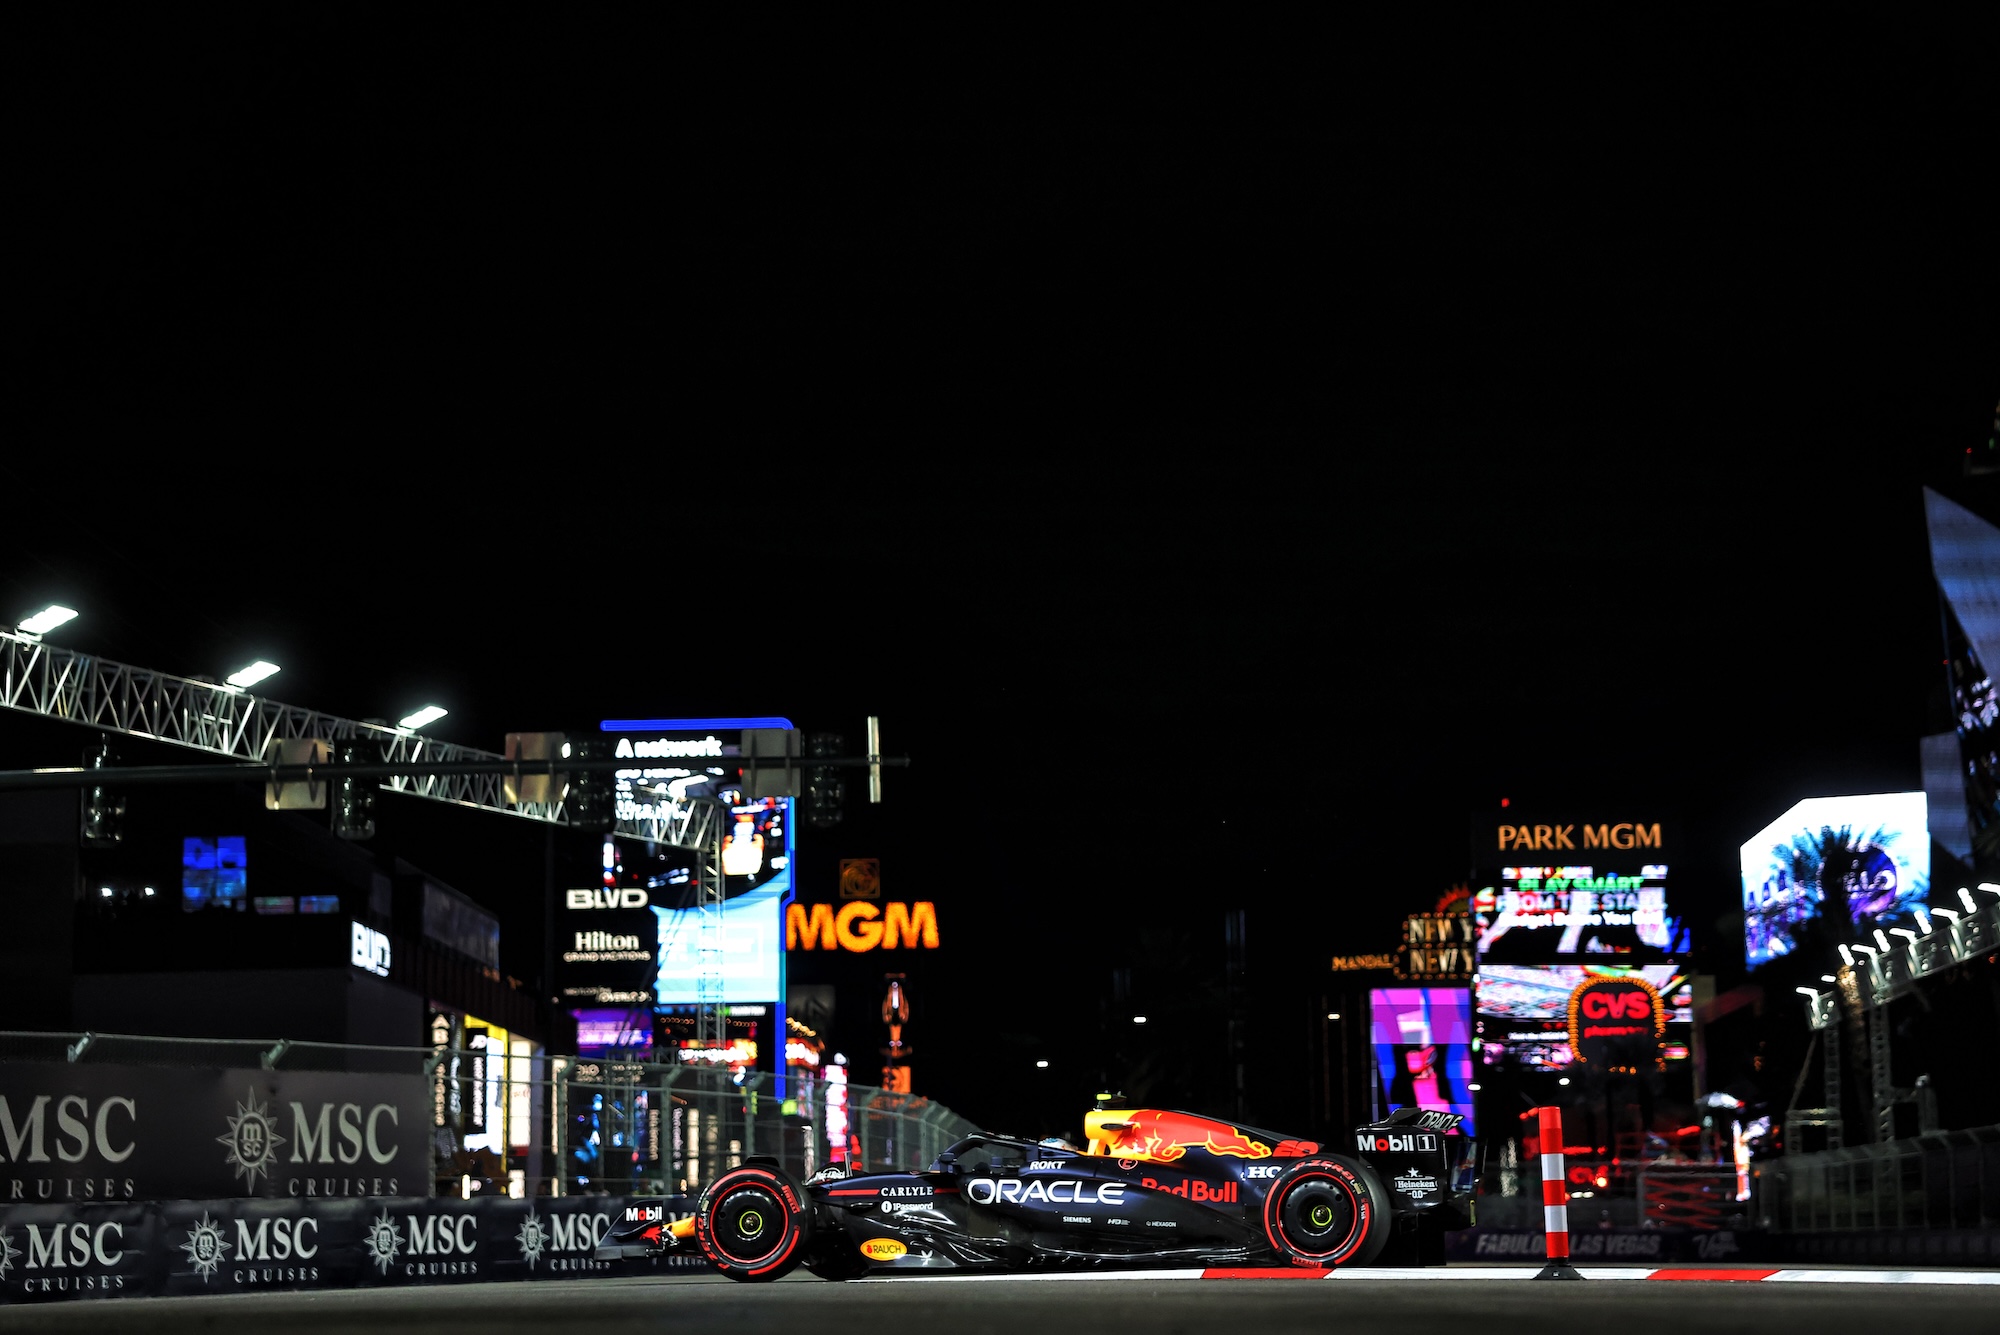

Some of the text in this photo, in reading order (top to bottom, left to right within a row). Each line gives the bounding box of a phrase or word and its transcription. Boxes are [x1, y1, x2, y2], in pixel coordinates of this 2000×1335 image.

[1497, 822, 1663, 851] PARK MGM
[1572, 876, 1645, 891] SMART
[566, 887, 648, 909] BLVD
[786, 901, 939, 953] MGM
[575, 930, 640, 951] Hilton
[1582, 991, 1651, 1019] CVS
[289, 1102, 399, 1164] MSC
[1357, 1134, 1415, 1152] Mobil
[1029, 1161, 1066, 1171] ROKT
[288, 1178, 399, 1197] CRUISES
[881, 1186, 934, 1197] CARLYLE
[967, 1178, 1128, 1205] ORACLE
[1191, 1180, 1239, 1203] Bull
[626, 1206, 663, 1222] Mobil
[1063, 1216, 1092, 1224] SIEMENS
[234, 1216, 319, 1261] MSC
[407, 1214, 477, 1255] MSC
[551, 1213, 610, 1250] MSC
[25, 1221, 123, 1268] MSC
[873, 1244, 901, 1254] RAUCH
[234, 1265, 319, 1285] CRUISES
[406, 1261, 478, 1275] CRUISES
[24, 1275, 123, 1293] CRUISES
